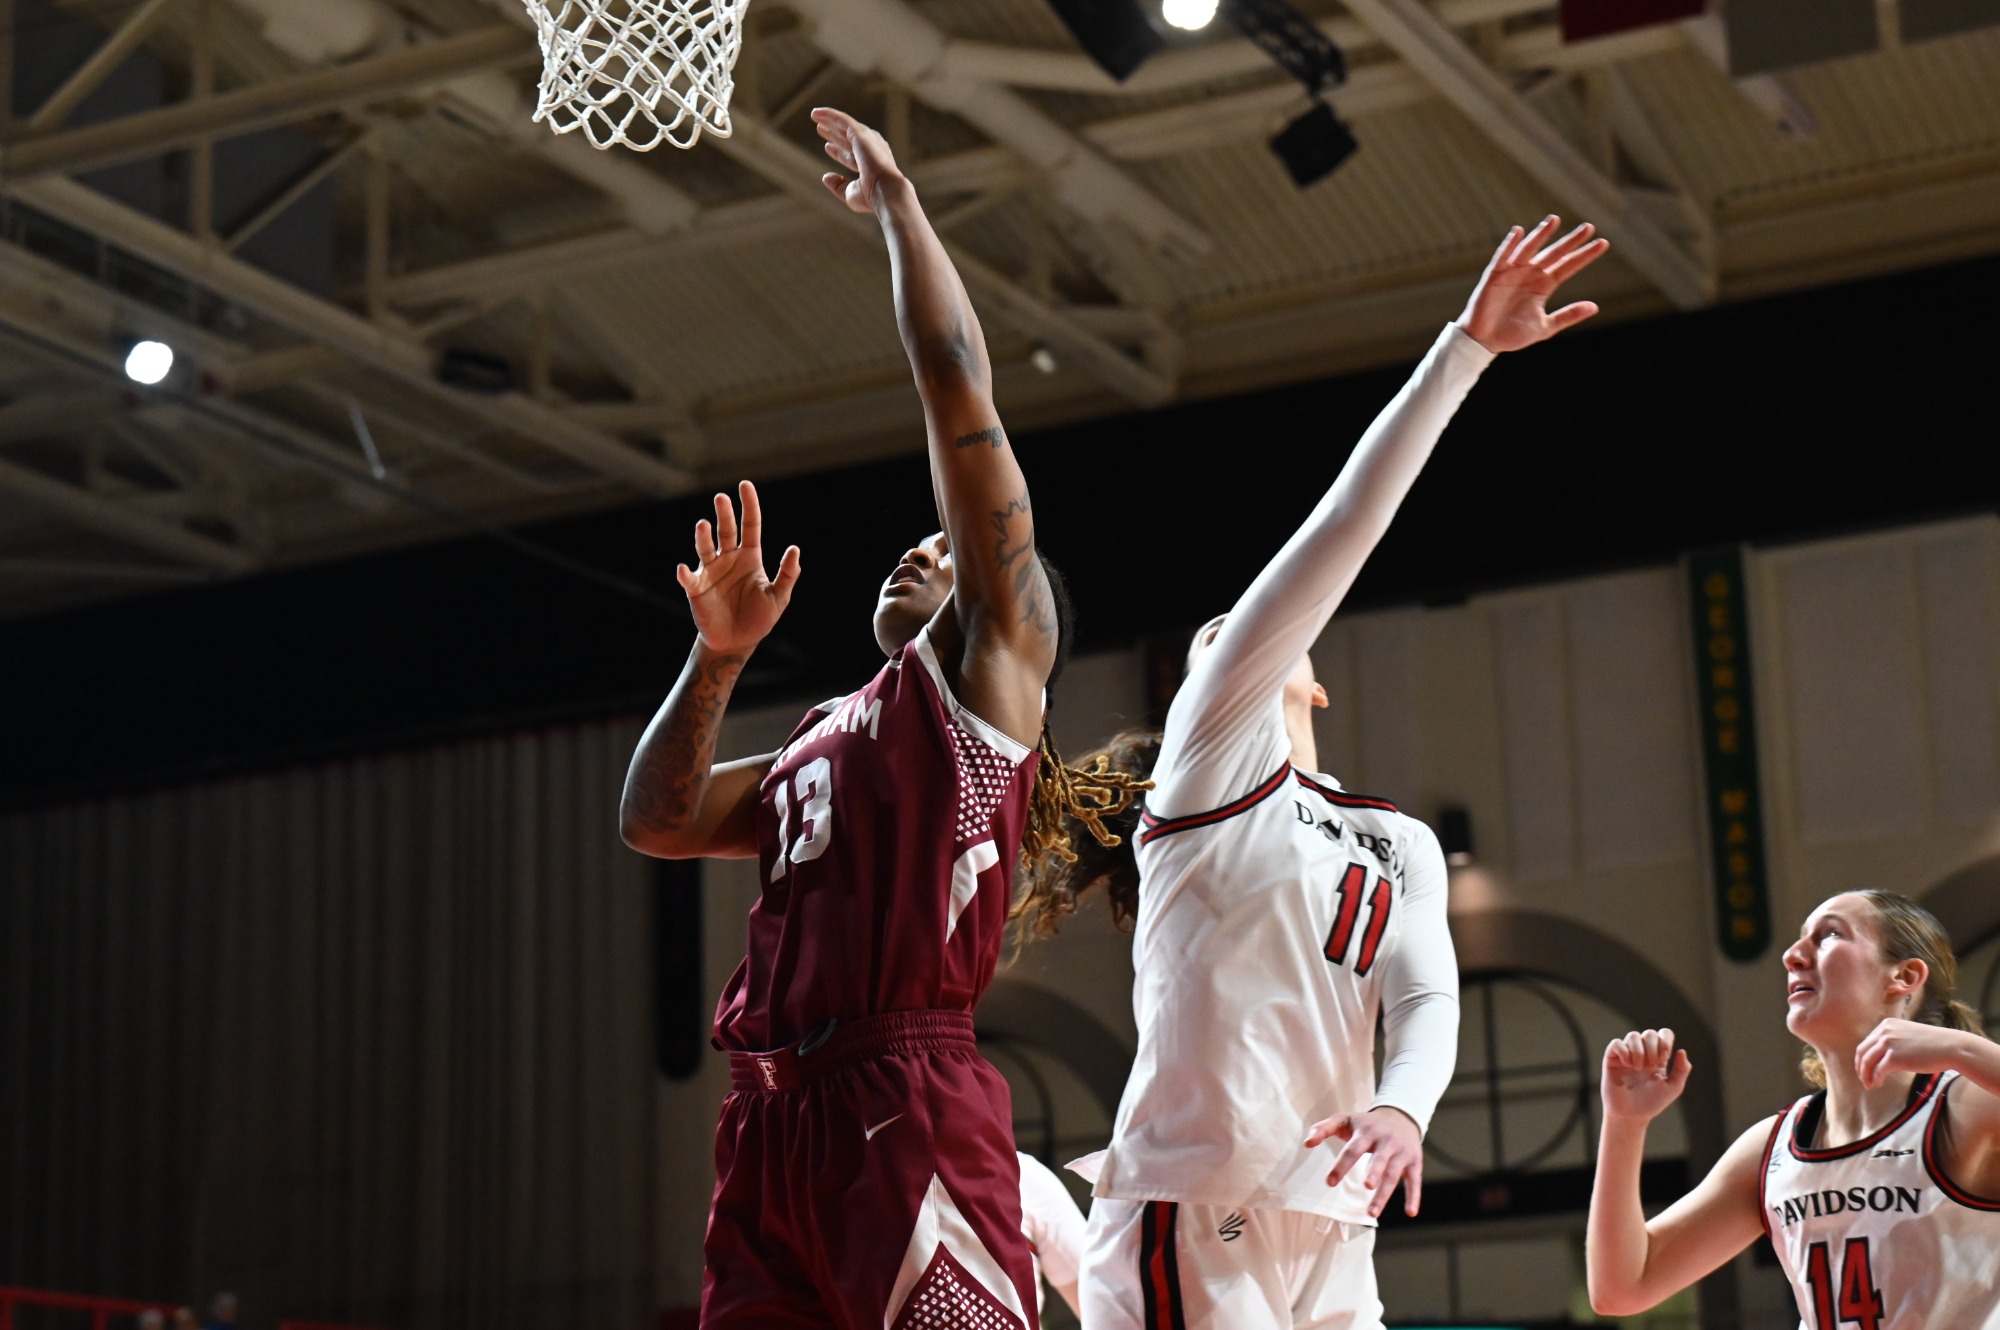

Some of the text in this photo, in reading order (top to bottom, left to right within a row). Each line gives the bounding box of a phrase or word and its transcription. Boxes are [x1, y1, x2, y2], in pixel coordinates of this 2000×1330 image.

[1703, 572, 1756, 941] GEORGE MASON
[769, 757, 832, 884] 13
[1323, 862, 1392, 977] 11
[1807, 1236, 1884, 1330] 14
